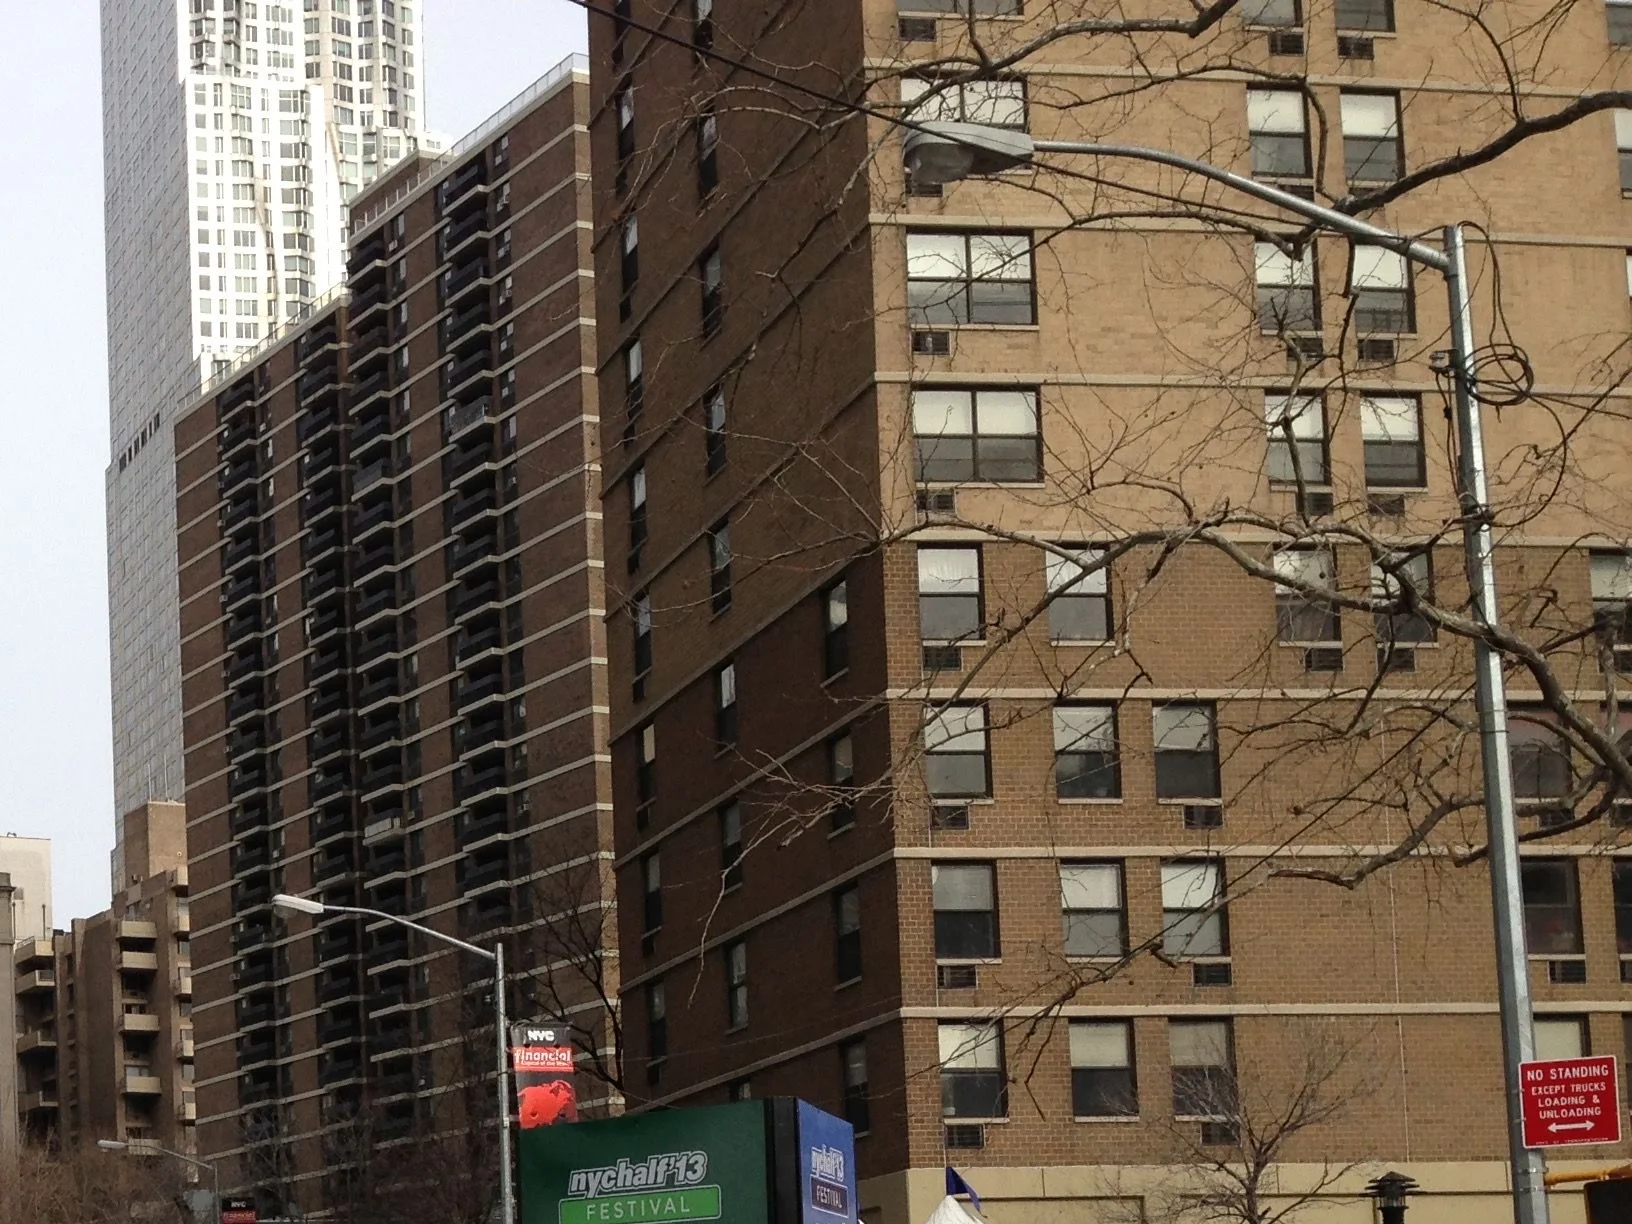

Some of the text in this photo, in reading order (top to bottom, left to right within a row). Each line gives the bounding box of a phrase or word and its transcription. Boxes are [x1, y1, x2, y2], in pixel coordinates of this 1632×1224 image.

[527, 1030, 555, 1041] NYC
[514, 1048, 571, 1063] financial
[1526, 1064, 1609, 1081] NO STANDING
[1531, 1081, 1607, 1095] EXCEPT TRUCKS
[1538, 1094, 1600, 1107] LOADING &
[1539, 1106, 1602, 1119] UNLOADING
[816, 1184, 843, 1208] FESTIVAL
[586, 1196, 690, 1221] FESTIVAL
